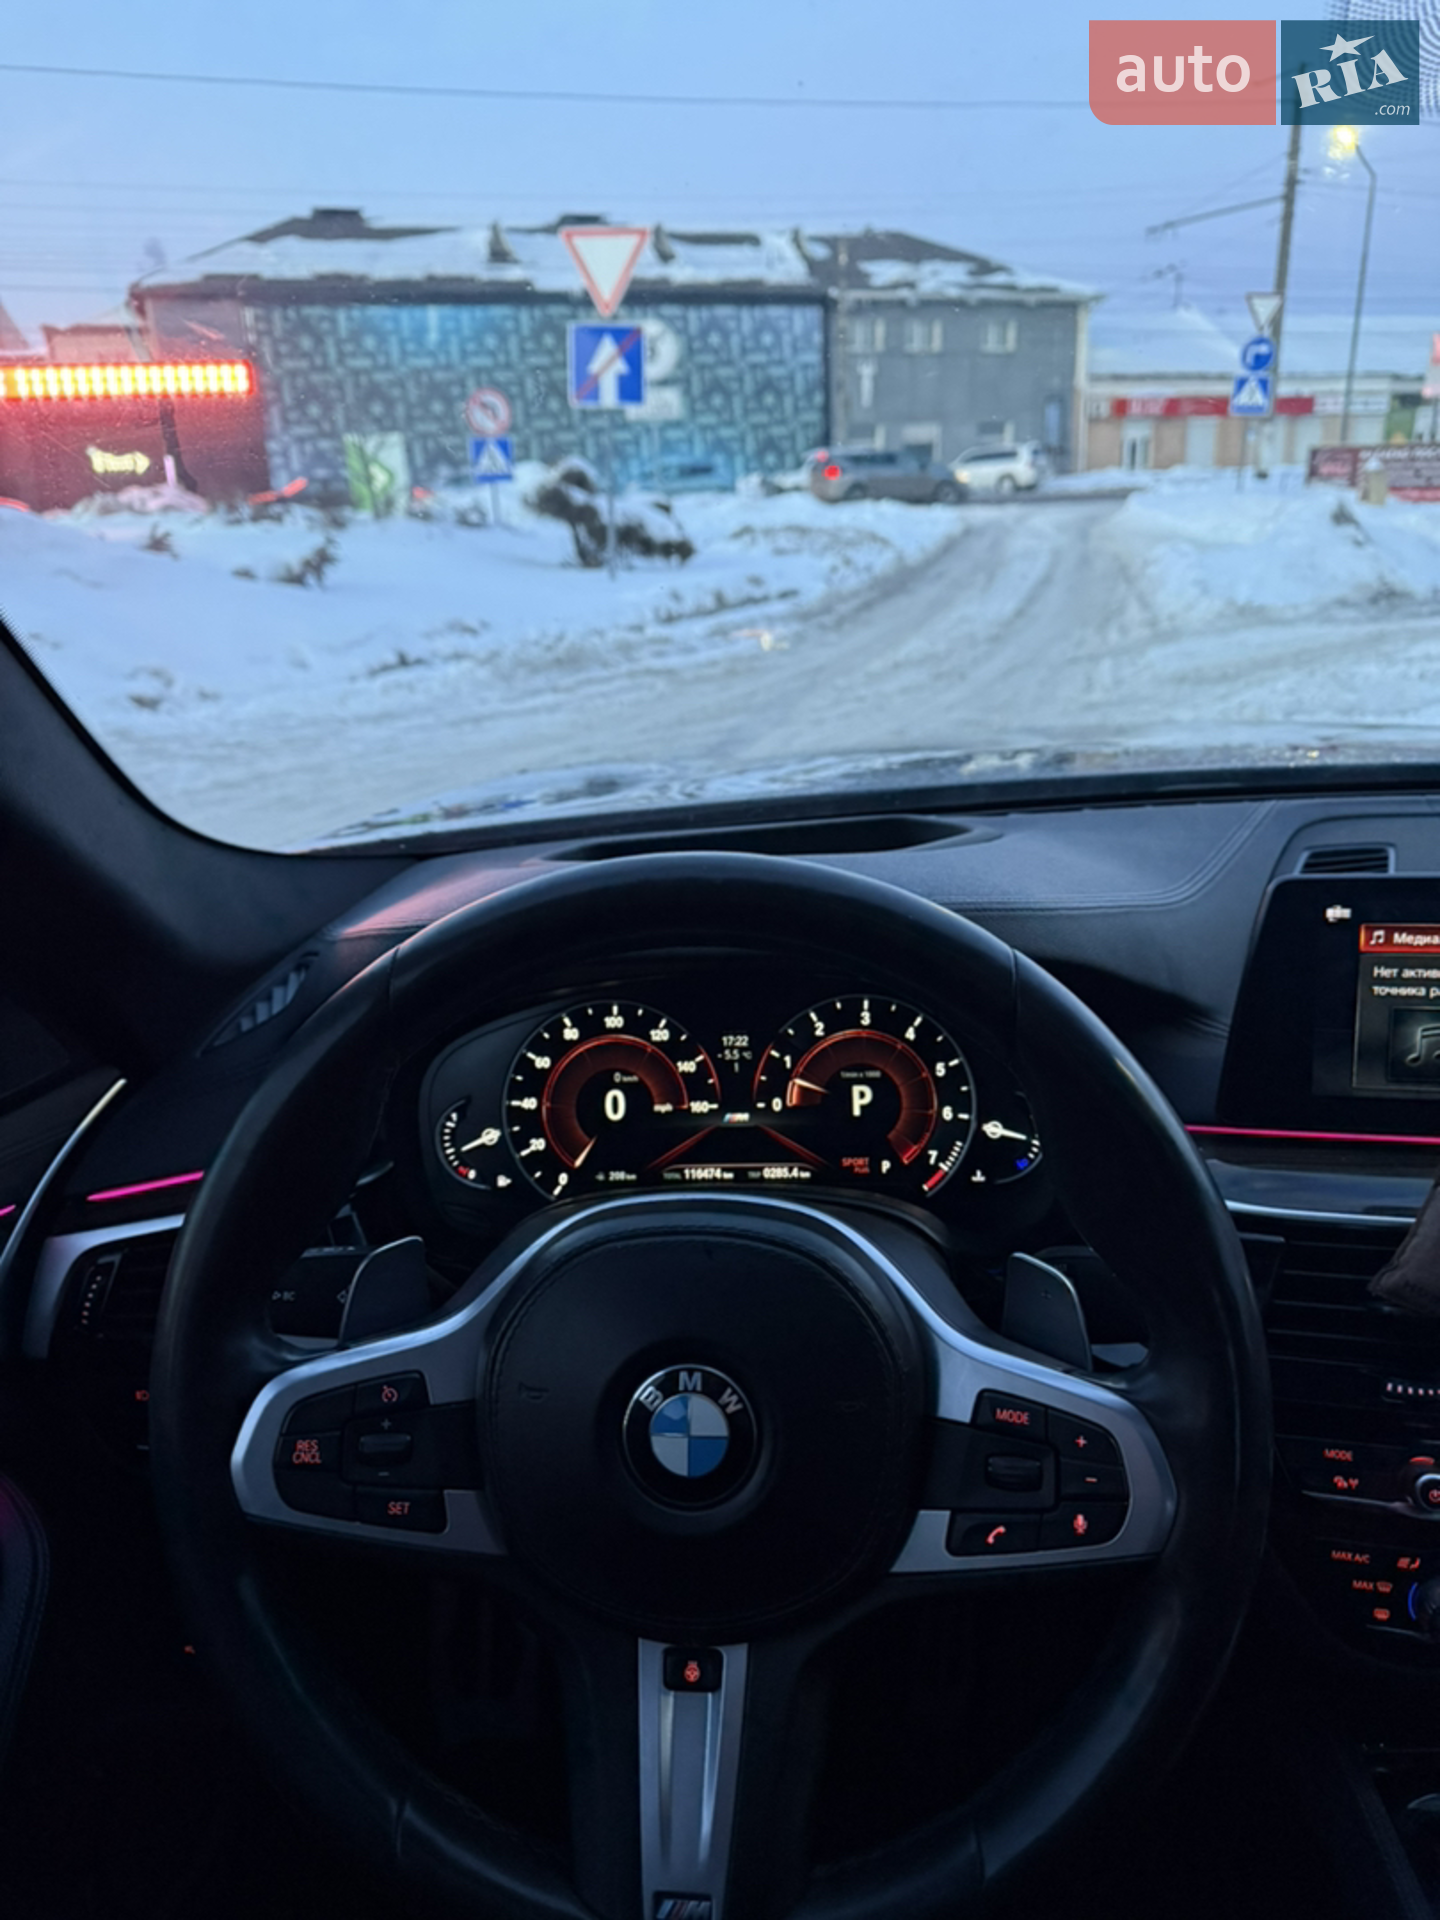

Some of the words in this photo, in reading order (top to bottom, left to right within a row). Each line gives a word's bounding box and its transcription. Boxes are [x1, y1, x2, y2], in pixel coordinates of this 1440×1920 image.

[604, 1016, 625, 1029] 100
[860, 1011, 871, 1026] 3
[814, 1021, 825, 1036] 2
[905, 1026, 916, 1041] 4
[722, 1035, 749, 1047] 17:22
[783, 1055, 792, 1069] 1
[935, 1062, 947, 1077] 5
[604, 1089, 626, 1121] 0
[771, 1097, 782, 1112] 0
[851, 1085, 873, 1117] P
[942, 1105, 954, 1121] 6
[927, 1150, 938, 1165] 7
[881, 1160, 891, 1174] P
[558, 1172, 568, 1186] 0
[639, 1371, 744, 1415] BMW
[996, 1409, 1030, 1425] MODE
[295, 1440, 318, 1452] RES
[1323, 1449, 1353, 1462] MODE
[387, 1502, 411, 1515] SET
[1331, 1550, 1352, 1561] MAX
[1352, 1580, 1374, 1592] MAX
